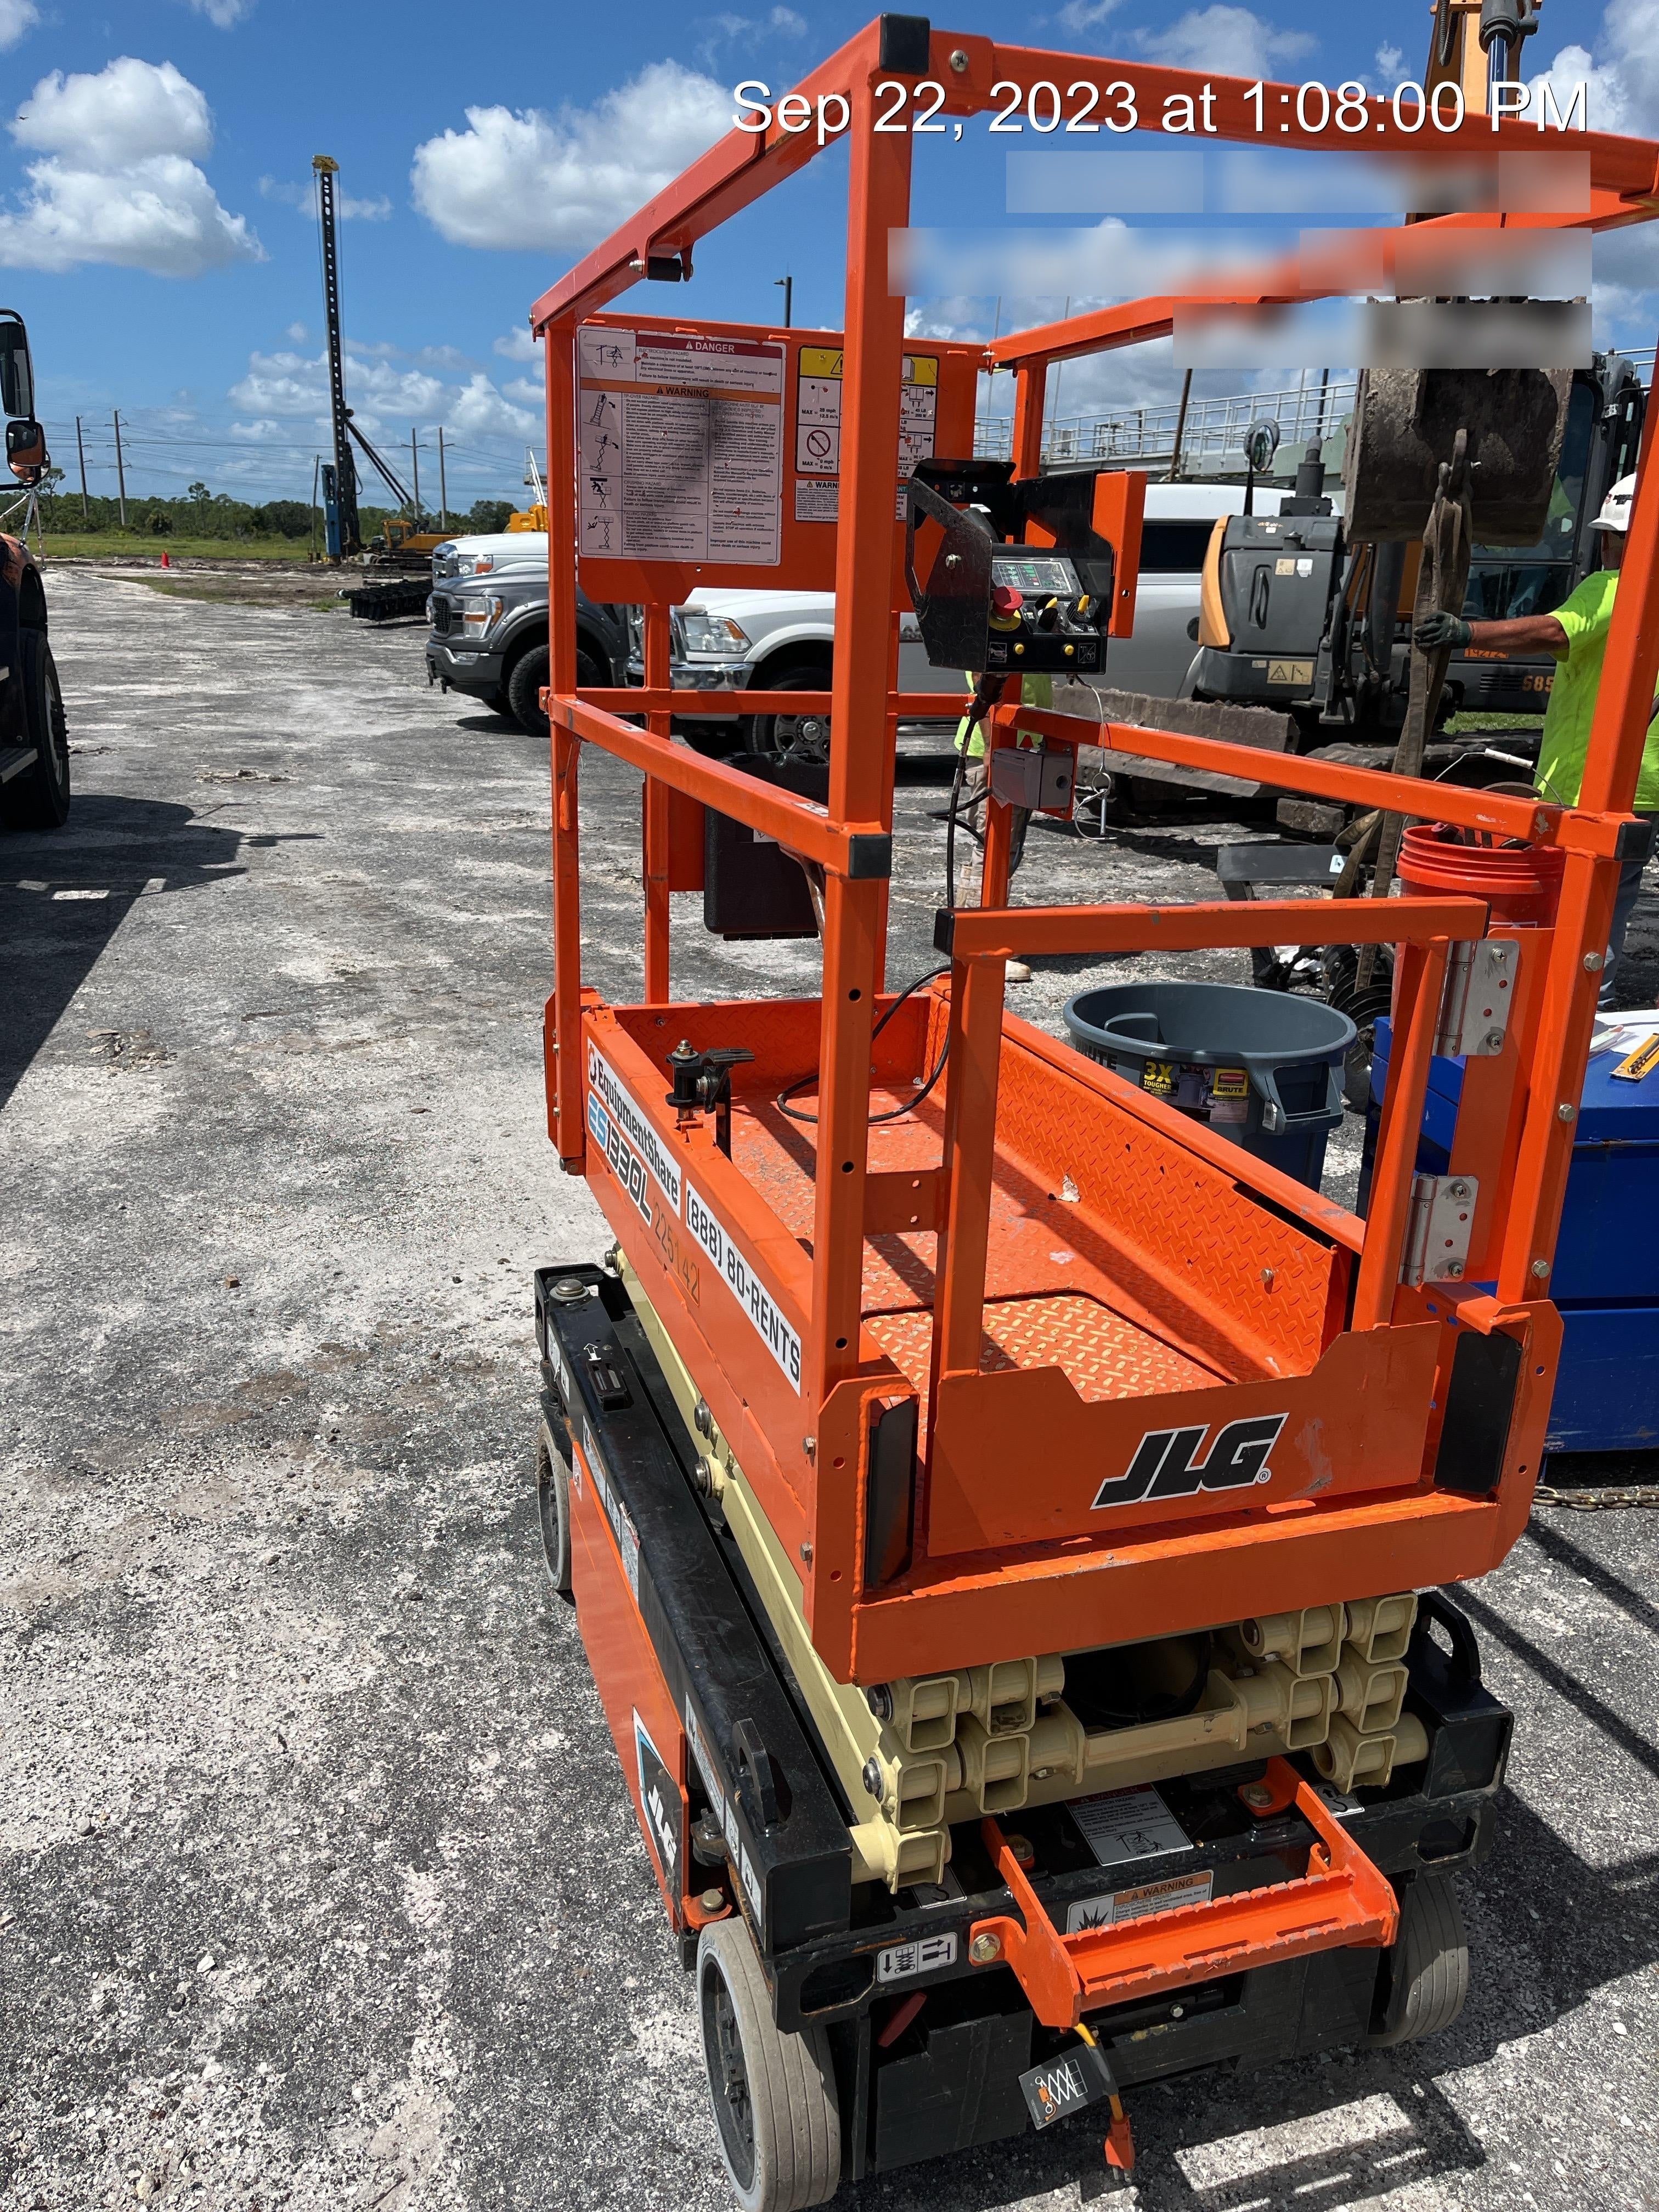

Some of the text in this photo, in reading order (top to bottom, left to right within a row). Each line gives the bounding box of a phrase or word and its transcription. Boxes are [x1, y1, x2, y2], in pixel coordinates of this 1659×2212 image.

[695, 341, 735, 354] DANGER
[665, 386, 709, 398] WARNING
[1144, 1061, 1173, 1084] 3X
[1143, 1080, 1172, 1090] TOUGHER
[596, 1058, 679, 1205] EquipmentShare
[588, 1088, 652, 1229] ES1330L
[686, 1188, 801, 1383] (888) 80-RENTS
[1090, 1412, 1289, 1509] JLG
[1092, 1787, 1140, 1801] DANGER
[1143, 1877, 1193, 1897] WARNING
